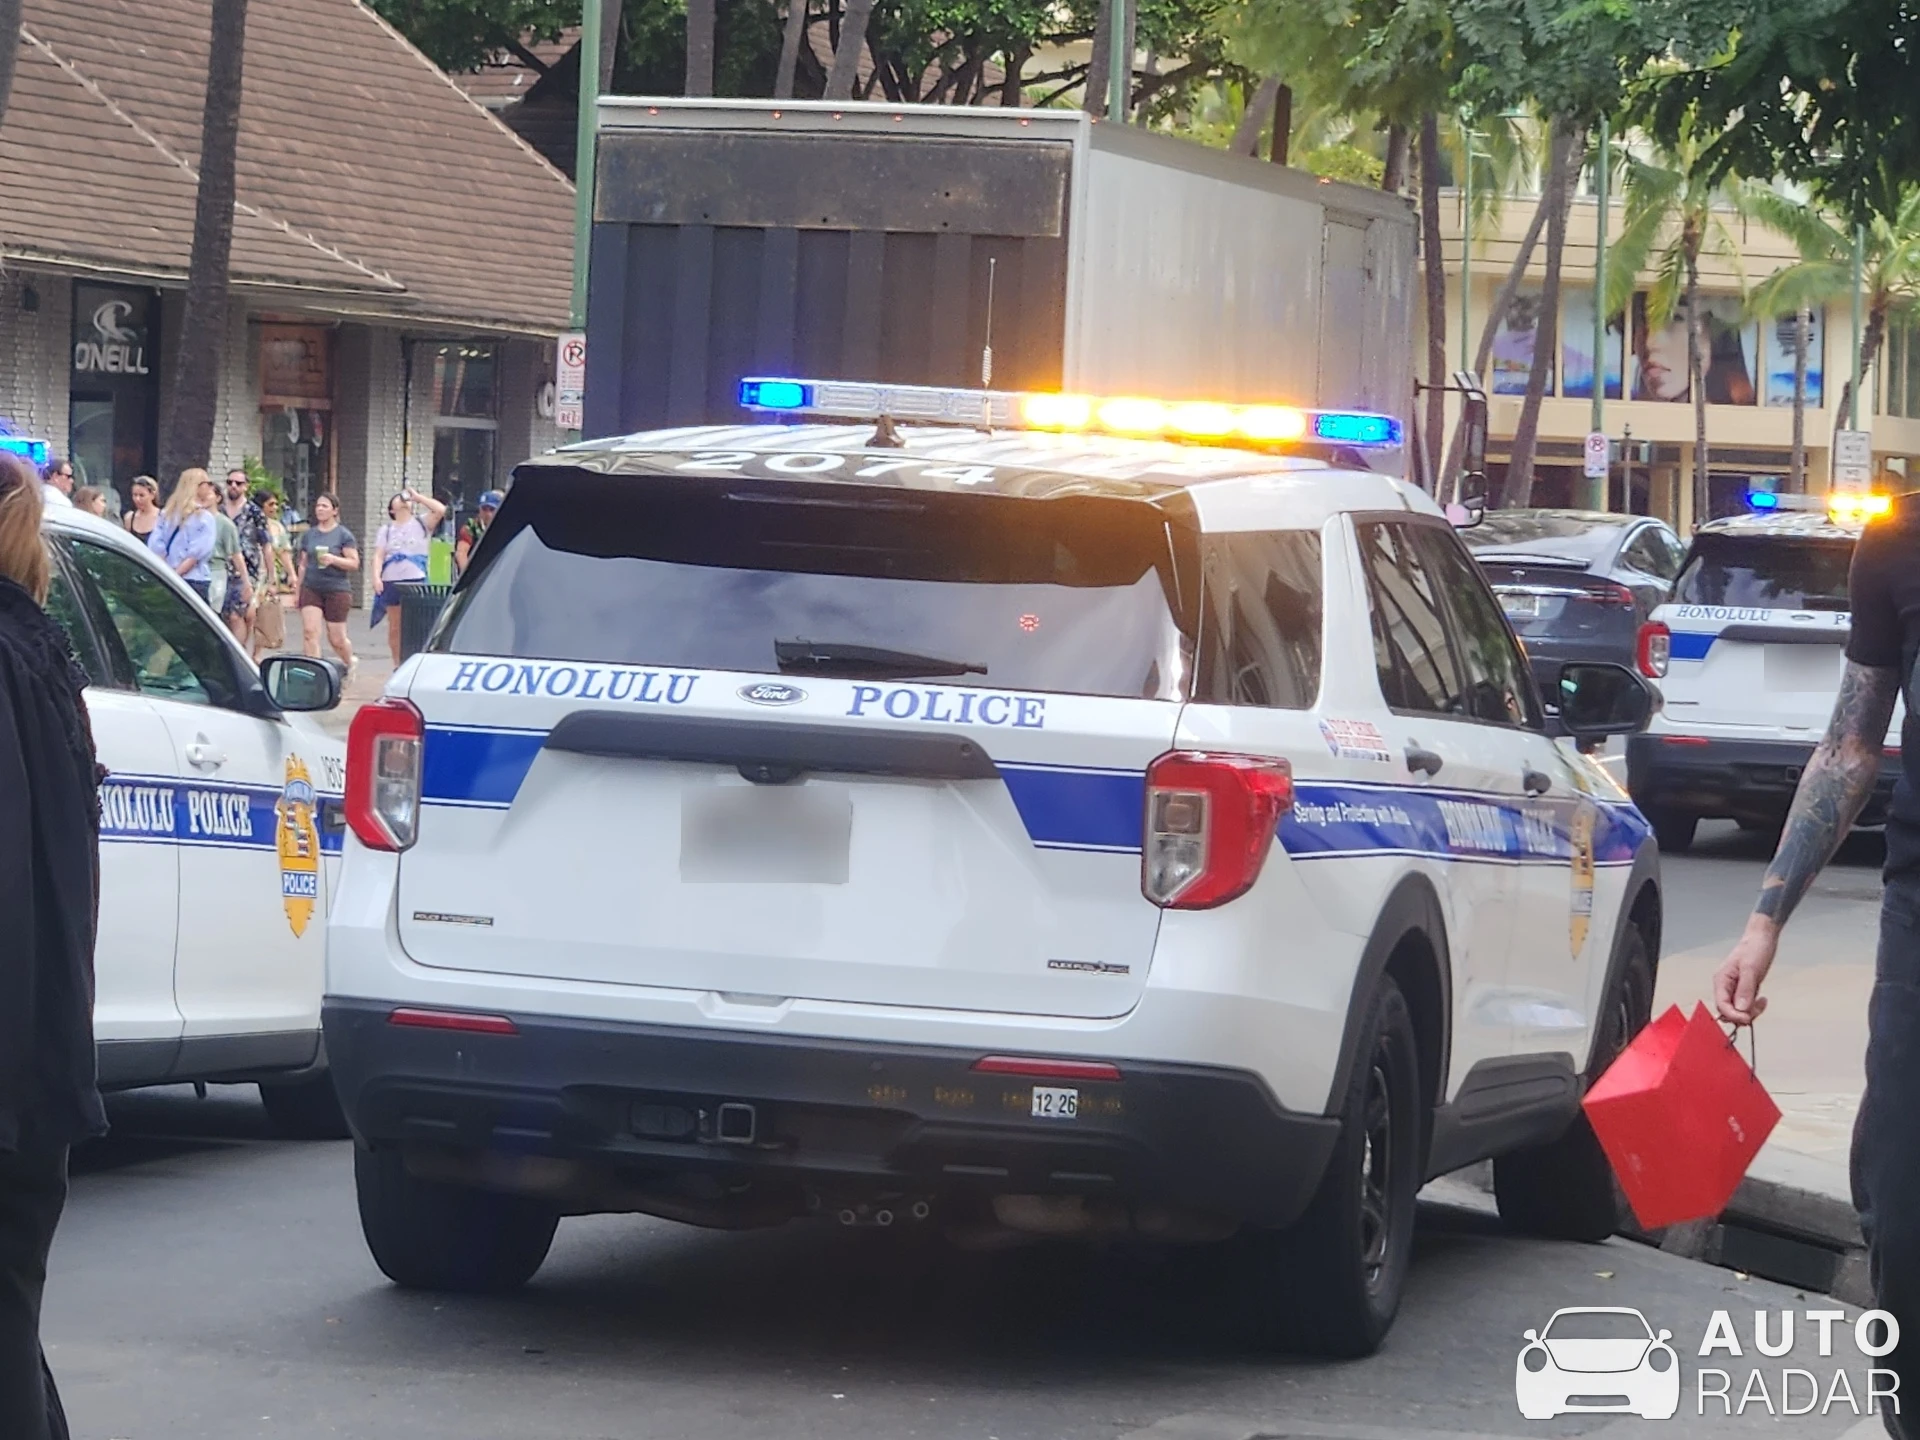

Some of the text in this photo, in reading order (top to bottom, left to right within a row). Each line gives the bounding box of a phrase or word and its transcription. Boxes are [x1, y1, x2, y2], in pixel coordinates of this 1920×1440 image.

[676, 451, 996, 485] 2074
[1677, 605, 1771, 622] HONOLULU
[446, 661, 1047, 729] HONOLULU POLICE
[751, 684, 793, 701] Ford
[97, 784, 175, 832] NOLULU
[187, 790, 253, 836] POLICE
[1293, 801, 1327, 827] Serving
[1326, 802, 1342, 822] and
[283, 872, 317, 895] POLICE
[1036, 1092, 1051, 1113] 12
[1058, 1093, 1076, 1114] 26
